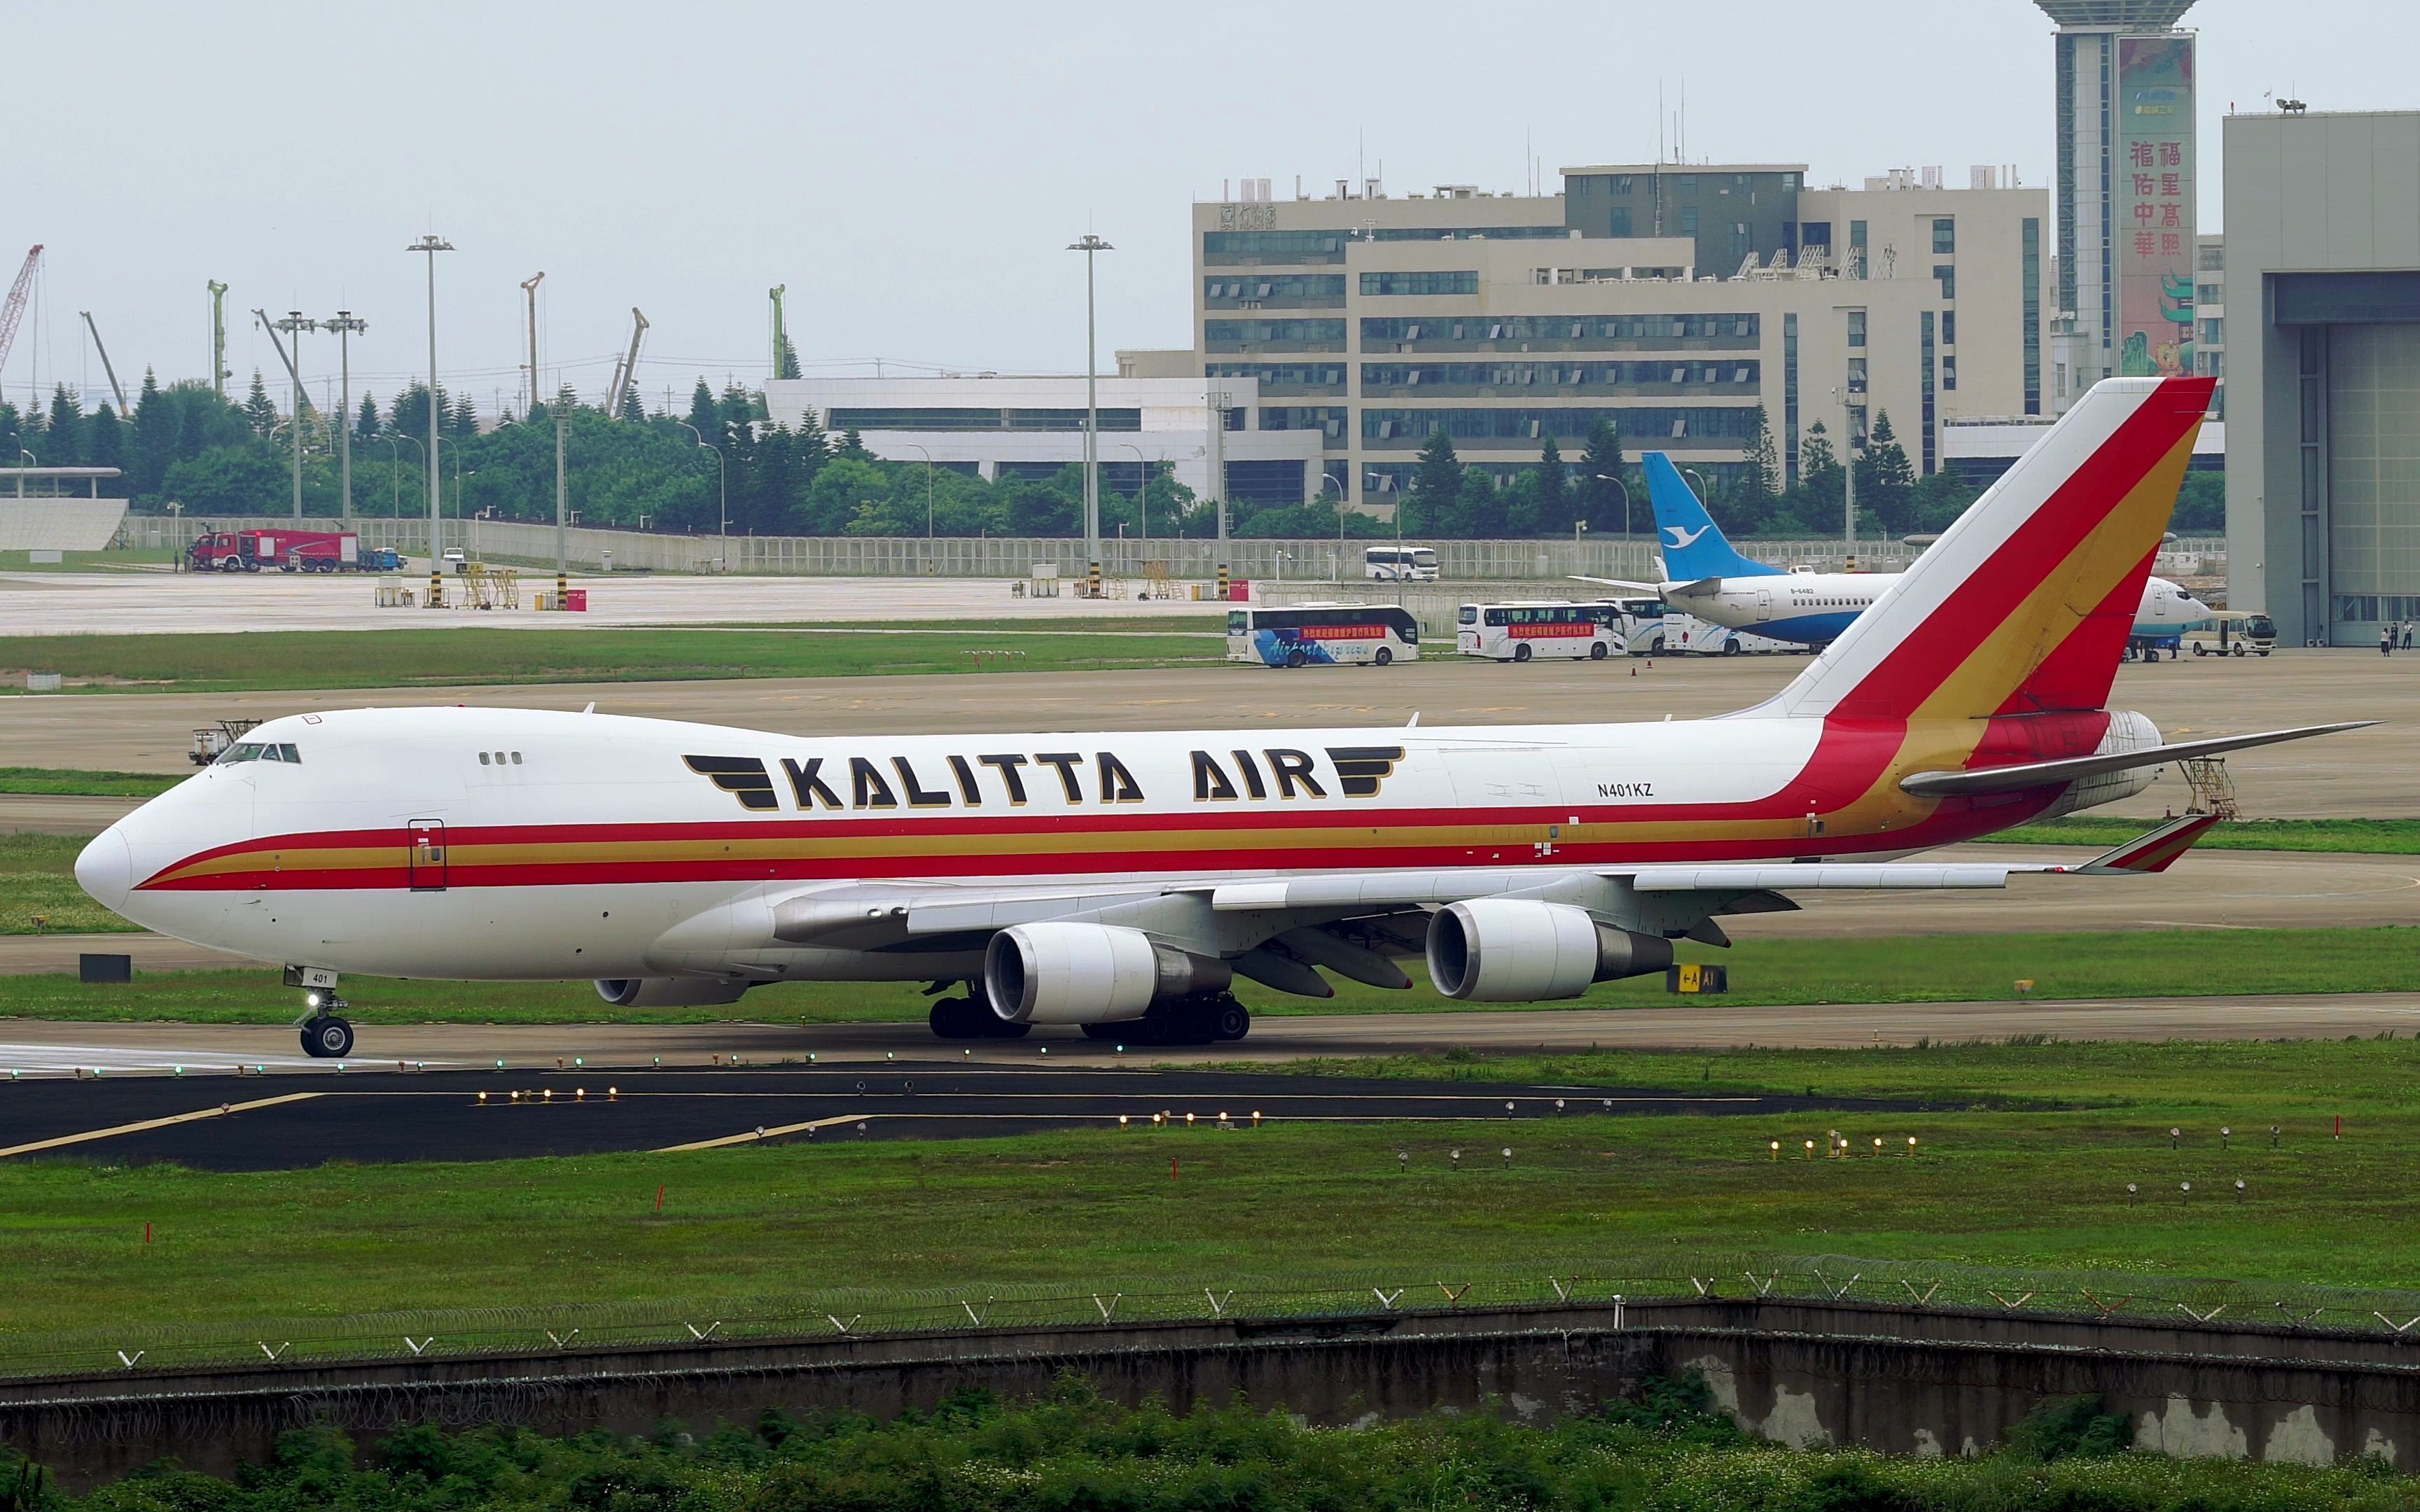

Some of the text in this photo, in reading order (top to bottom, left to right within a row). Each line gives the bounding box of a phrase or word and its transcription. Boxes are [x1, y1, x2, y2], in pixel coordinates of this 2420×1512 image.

[778, 748, 1328, 811] KALITTA AIR
[1597, 783, 1654, 797] N401KZ
[313, 973, 328, 983] 401
[1691, 971, 1698, 986] A
